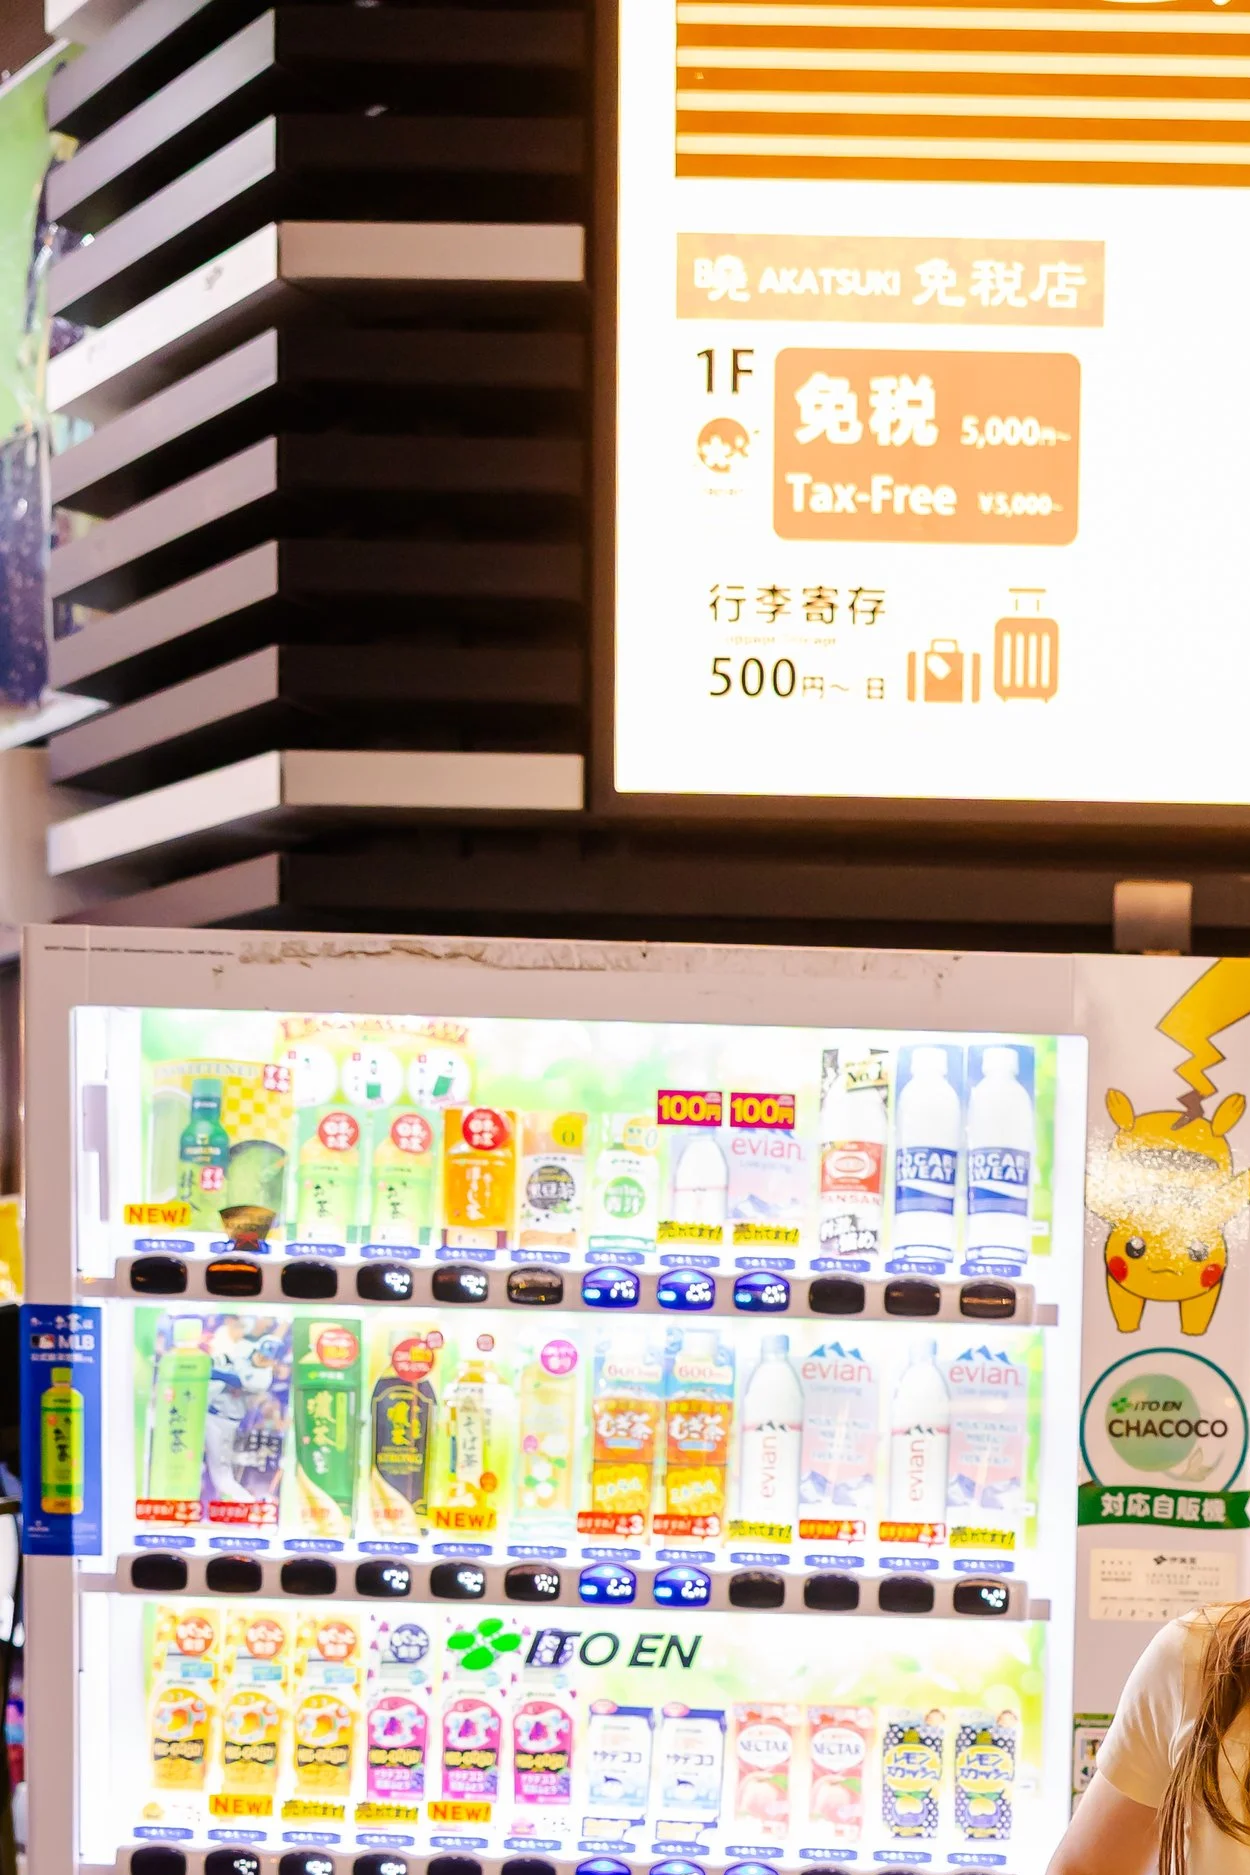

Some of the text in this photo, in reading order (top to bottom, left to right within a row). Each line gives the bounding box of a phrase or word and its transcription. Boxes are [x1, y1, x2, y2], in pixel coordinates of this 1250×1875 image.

[758, 267, 901, 297] AKATSUKI
[912, 257, 1088, 309] 免税店
[696, 347, 755, 395] 1F
[793, 371, 940, 447] 免税
[784, 472, 959, 516] Tax-Free
[709, 583, 886, 626] 行李寄存
[658, 1095, 722, 1122] 100円
[731, 1097, 794, 1125] 100円
[731, 1136, 803, 1161] evian
[129, 1207, 188, 1224] NEW!
[58, 1333, 95, 1351] MLB
[802, 1359, 873, 1384] evian
[949, 1363, 1020, 1386] evian
[1107, 1418, 1228, 1439] CHACOCO
[759, 1435, 777, 1499] evian
[908, 1438, 925, 1502] evian
[435, 1512, 495, 1529] NEW!
[1101, 1491, 1228, 1523] 対応自販機
[525, 1630, 621, 1668] ITO
[628, 1634, 703, 1669] EN
[213, 1797, 272, 1815] NEW!
[433, 1801, 491, 1820] NEW!
